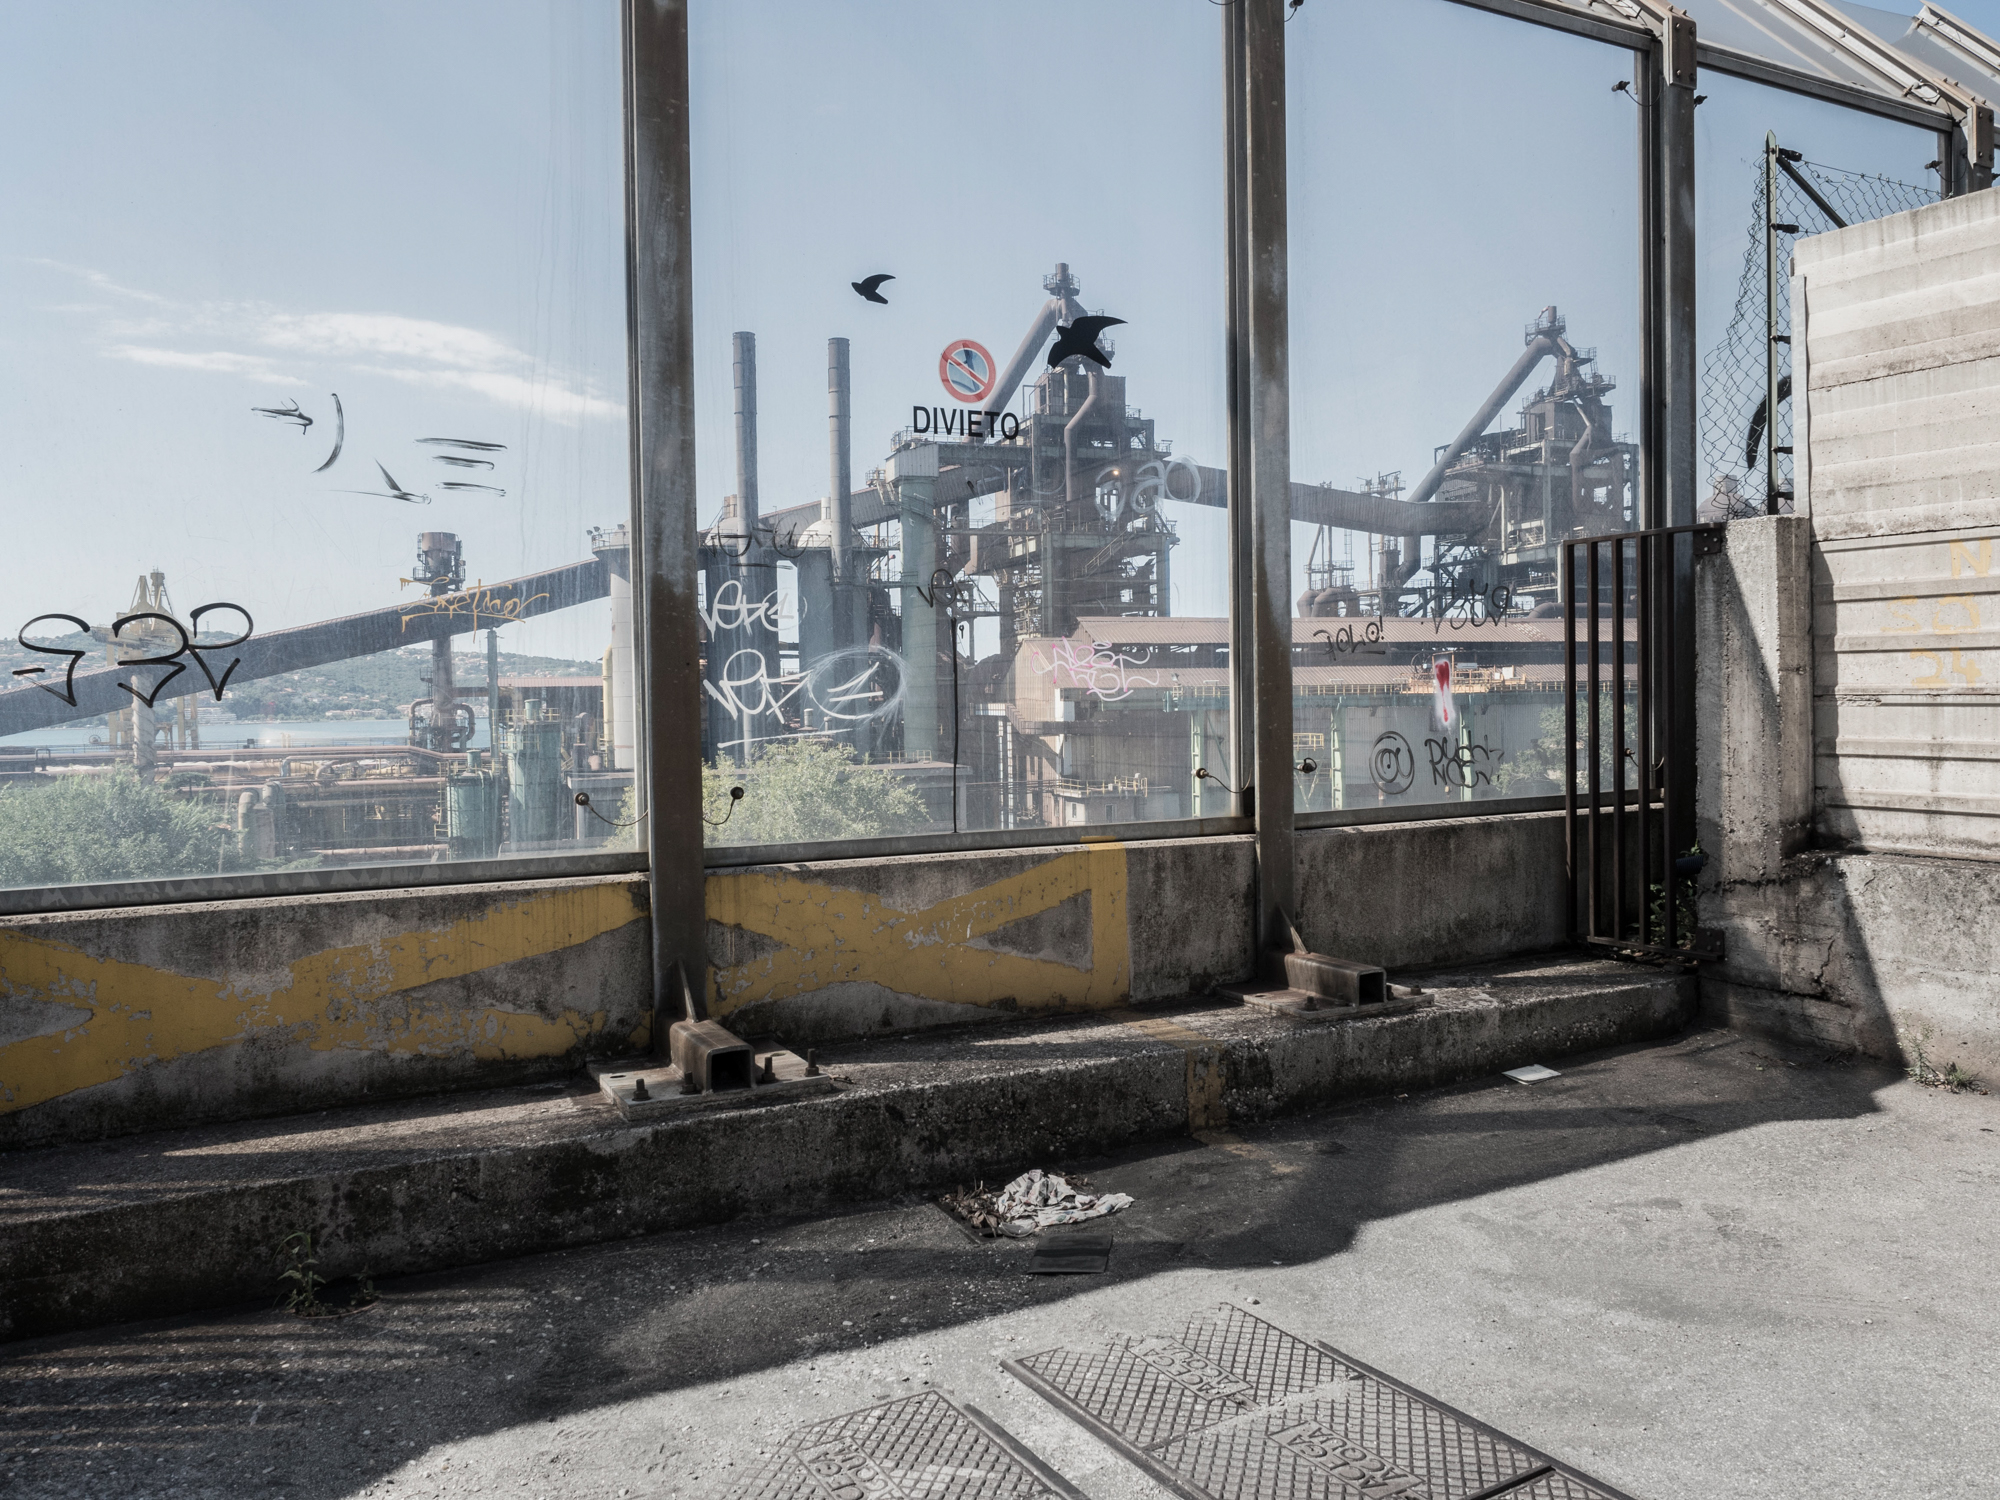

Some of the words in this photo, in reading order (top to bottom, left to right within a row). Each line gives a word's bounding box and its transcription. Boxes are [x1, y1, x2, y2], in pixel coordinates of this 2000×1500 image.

[913, 405, 1019, 440] DIVIETO
[1142, 1348, 1216, 1394] ACEGA
[1160, 1342, 1240, 1386] ACQUA
[1286, 1434, 1388, 1490] ACEGA
[1307, 1427, 1409, 1481] ACQUA
